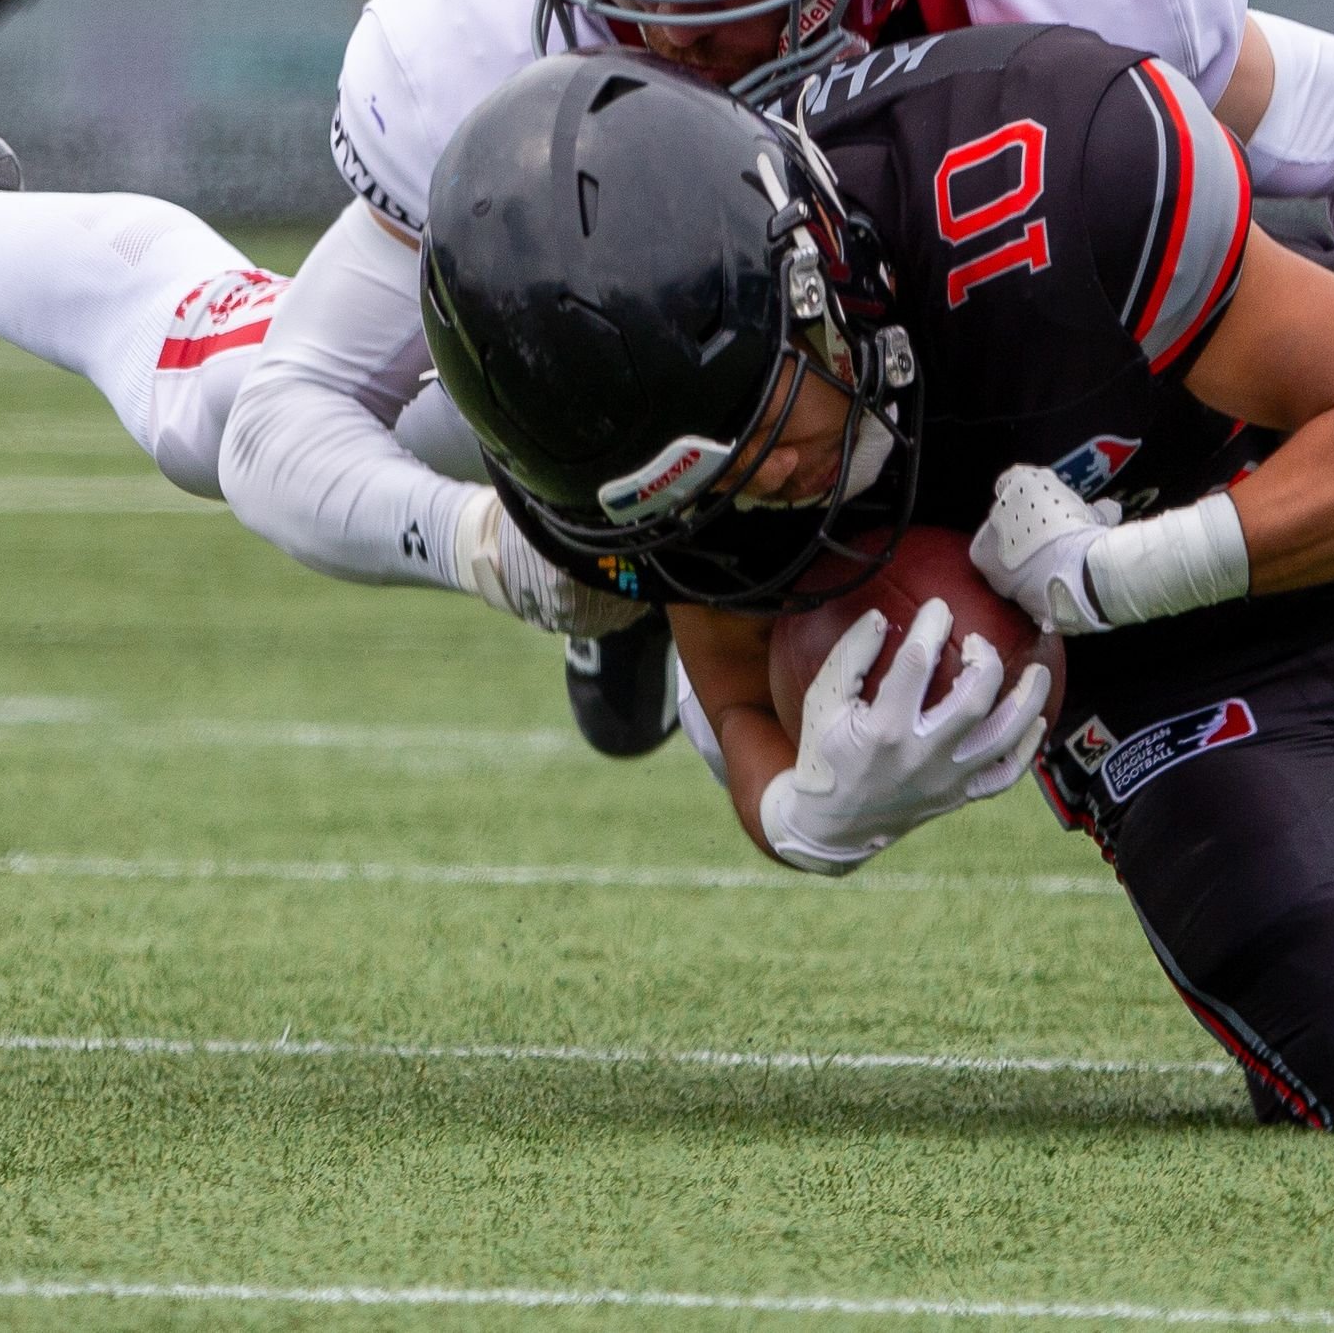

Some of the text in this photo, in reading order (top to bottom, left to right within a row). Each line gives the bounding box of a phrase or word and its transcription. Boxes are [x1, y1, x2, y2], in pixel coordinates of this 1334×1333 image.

[934, 117, 1052, 311] 10
[1108, 726, 1172, 773] EUROPEAN
[1111, 746, 1155, 783] LEAGUE
[1115, 746, 1176, 793] FOOTBALL
